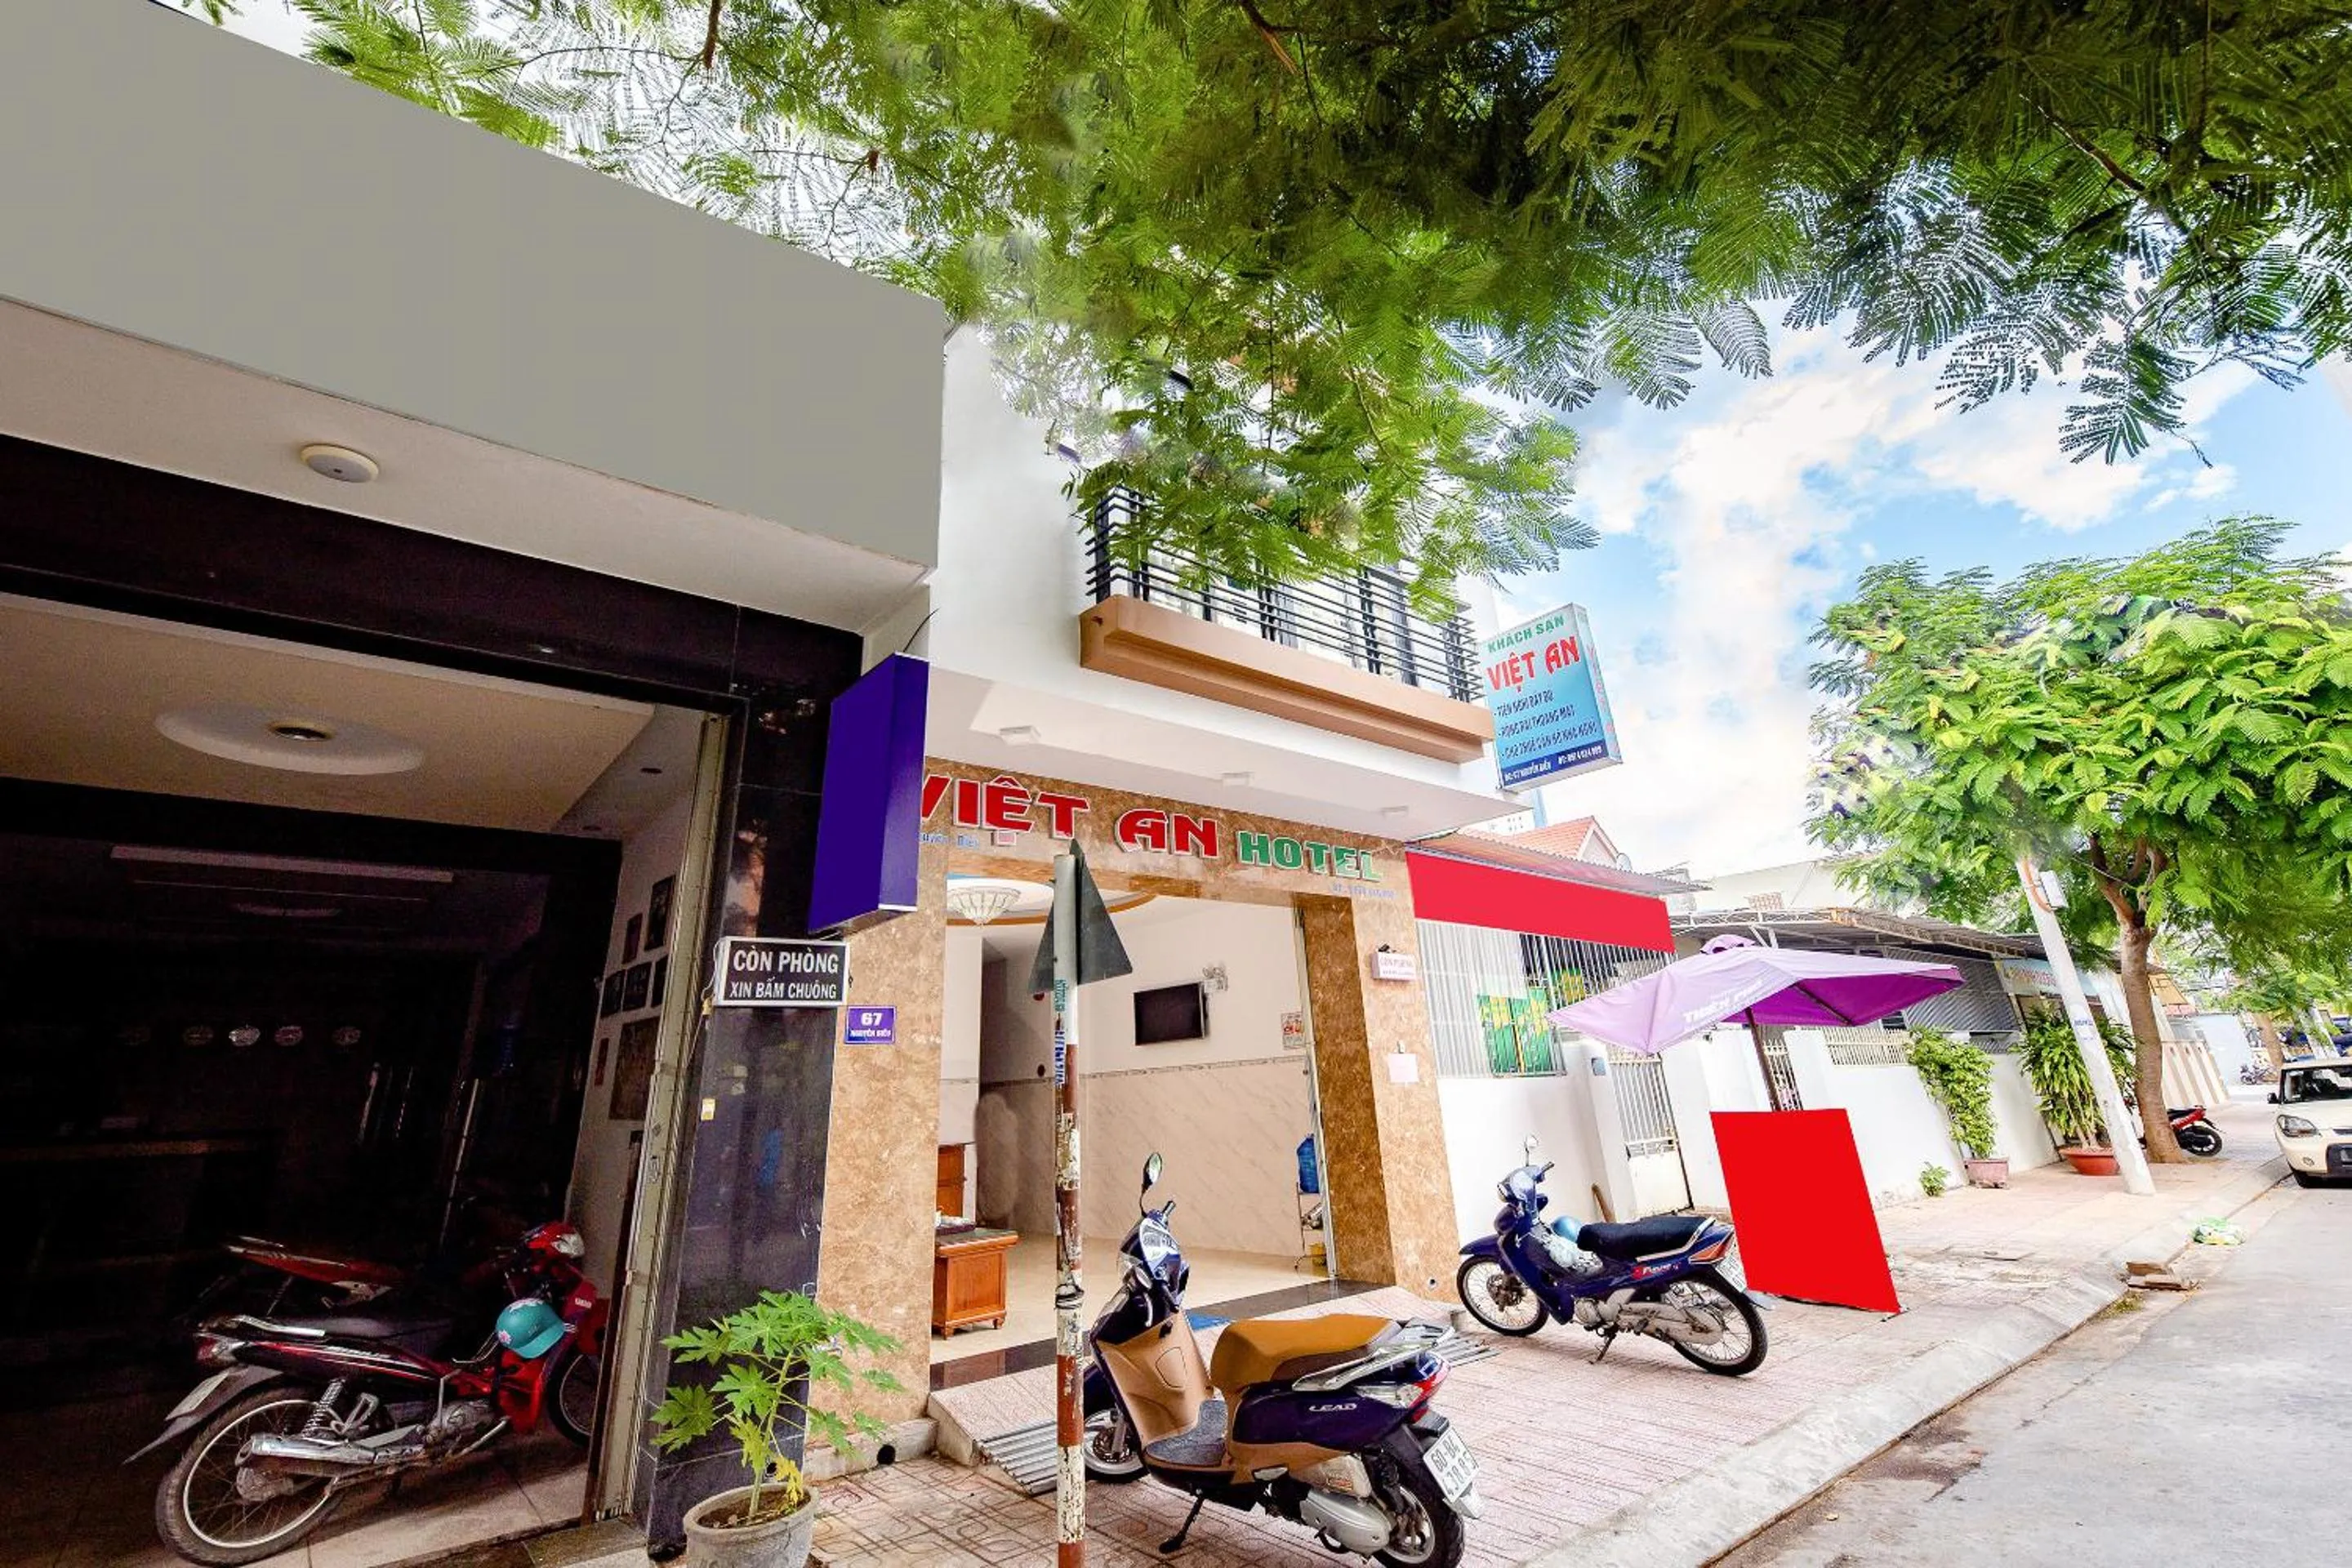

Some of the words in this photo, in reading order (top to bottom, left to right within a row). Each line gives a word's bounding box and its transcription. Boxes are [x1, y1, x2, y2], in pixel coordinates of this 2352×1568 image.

[1487, 650, 1535, 693] VIỆT
[1544, 636, 1579, 675] AN
[1114, 808, 1220, 859] AN
[1236, 830, 1383, 882] HOTEL
[733, 945, 773, 972] CÒN
[778, 947, 839, 973] PHÒNG
[729, 981, 752, 998] XIN
[755, 976, 784, 998] BẤM
[788, 980, 836, 999] CHUÔNG
[861, 1012, 883, 1027] 67
[1308, 1402, 1357, 1412] LEAD
